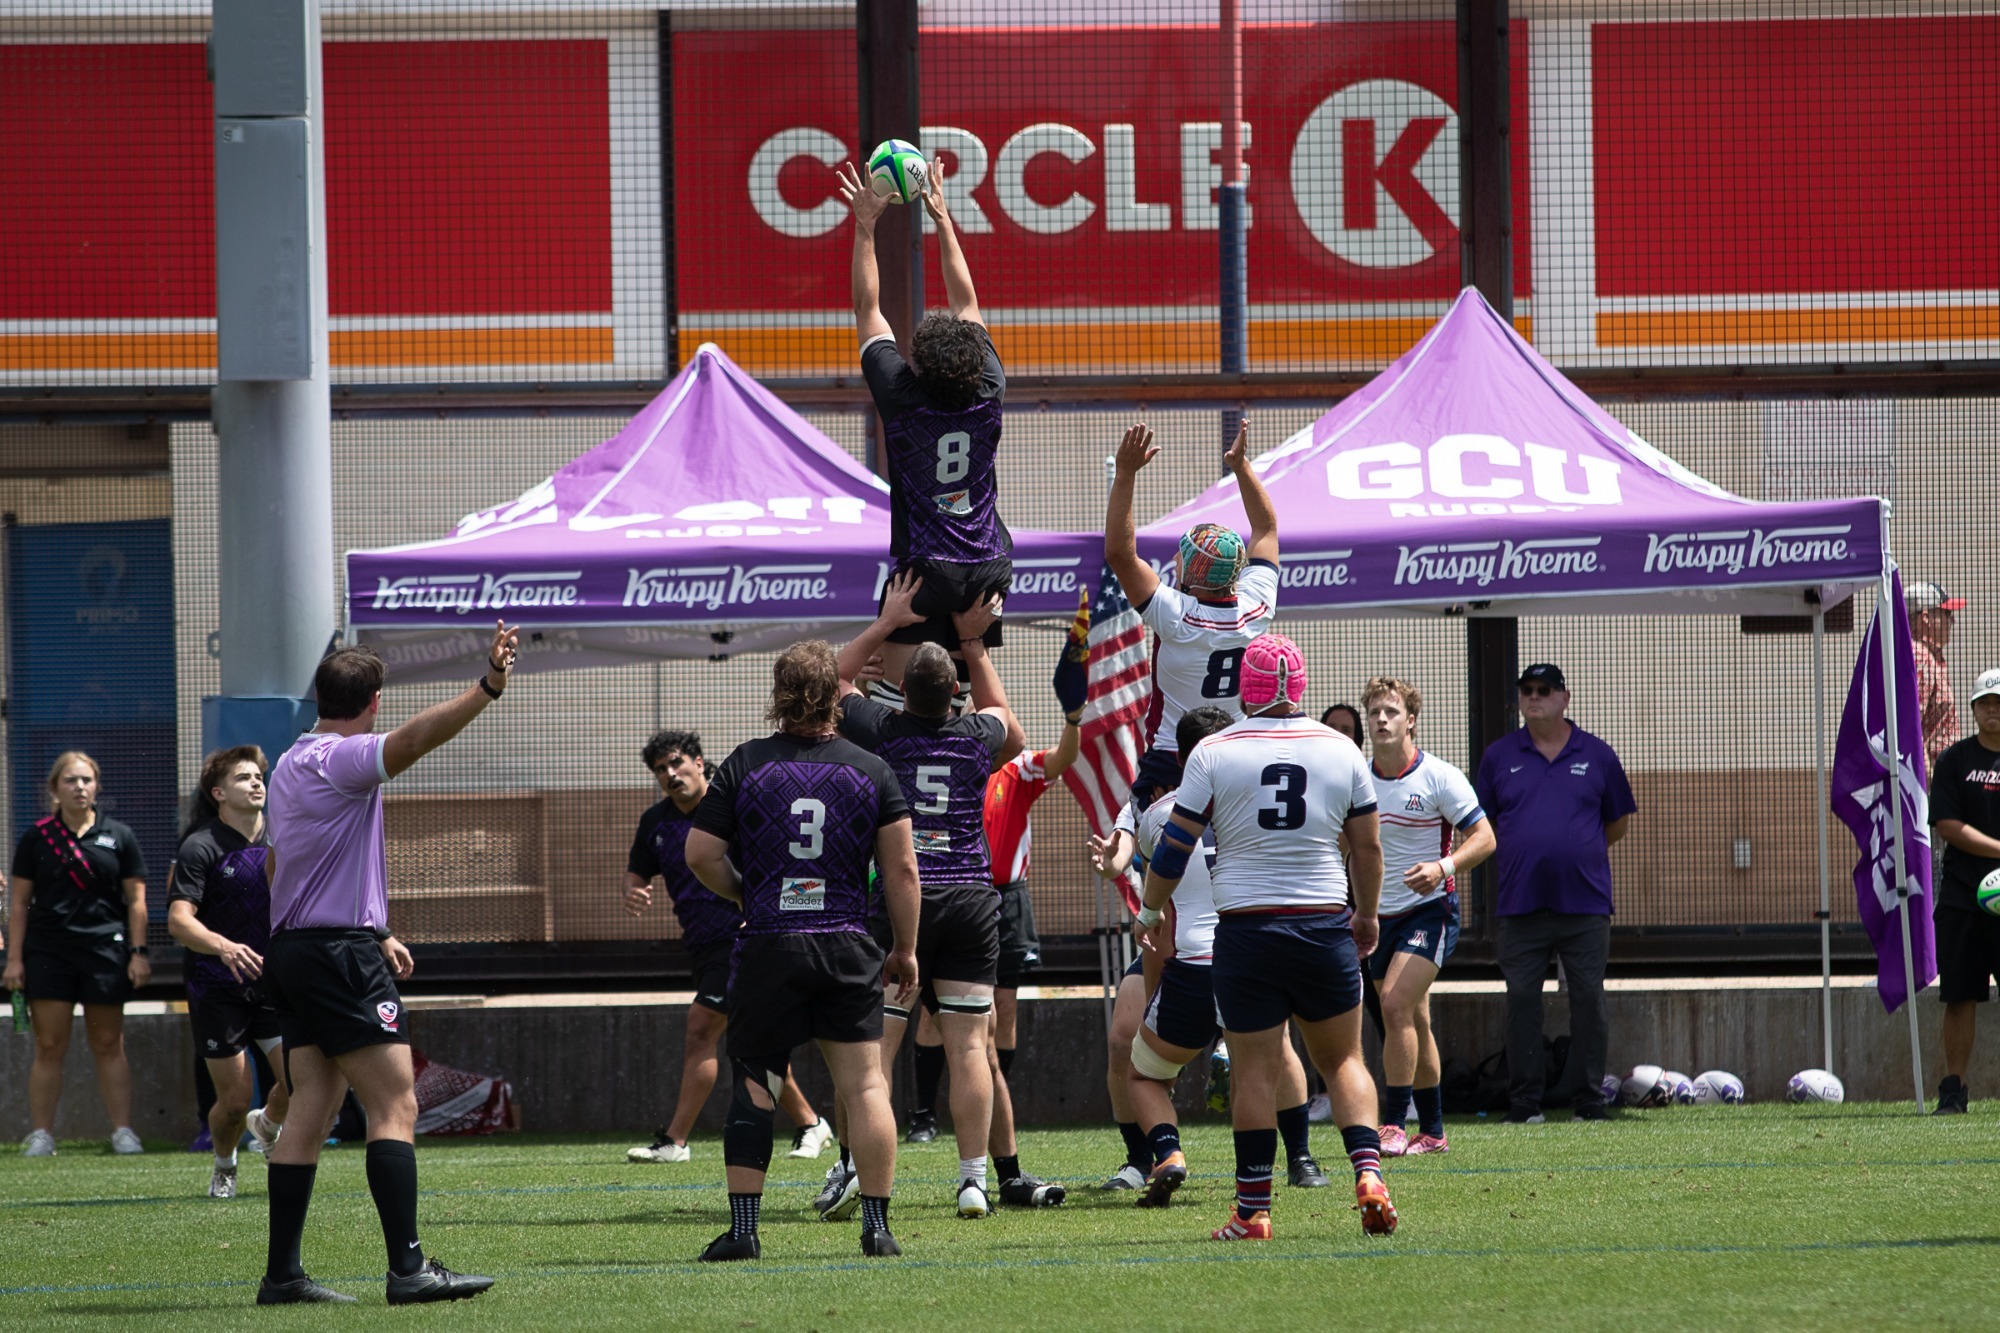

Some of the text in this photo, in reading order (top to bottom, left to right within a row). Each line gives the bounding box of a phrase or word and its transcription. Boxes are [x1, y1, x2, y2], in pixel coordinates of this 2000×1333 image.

[747, 122, 1253, 238] CRCLE
[936, 431, 971, 484] 8
[1326, 433, 1623, 505] GCU
[1278, 549, 1353, 588] reme
[1394, 536, 1602, 587] Krispy Kreme
[1644, 523, 1851, 575] Krispy Kreme
[372, 570, 583, 615] Krispy Kreme
[622, 566, 730, 611] Krispy
[728, 563, 832, 604] Kreme
[1201, 646, 1247, 698] 8
[914, 766, 951, 815] 5
[1257, 763, 1308, 830] 3
[1404, 794, 1425, 811] A
[788, 798, 826, 859] 3
[782, 896, 822, 906] Valadez
